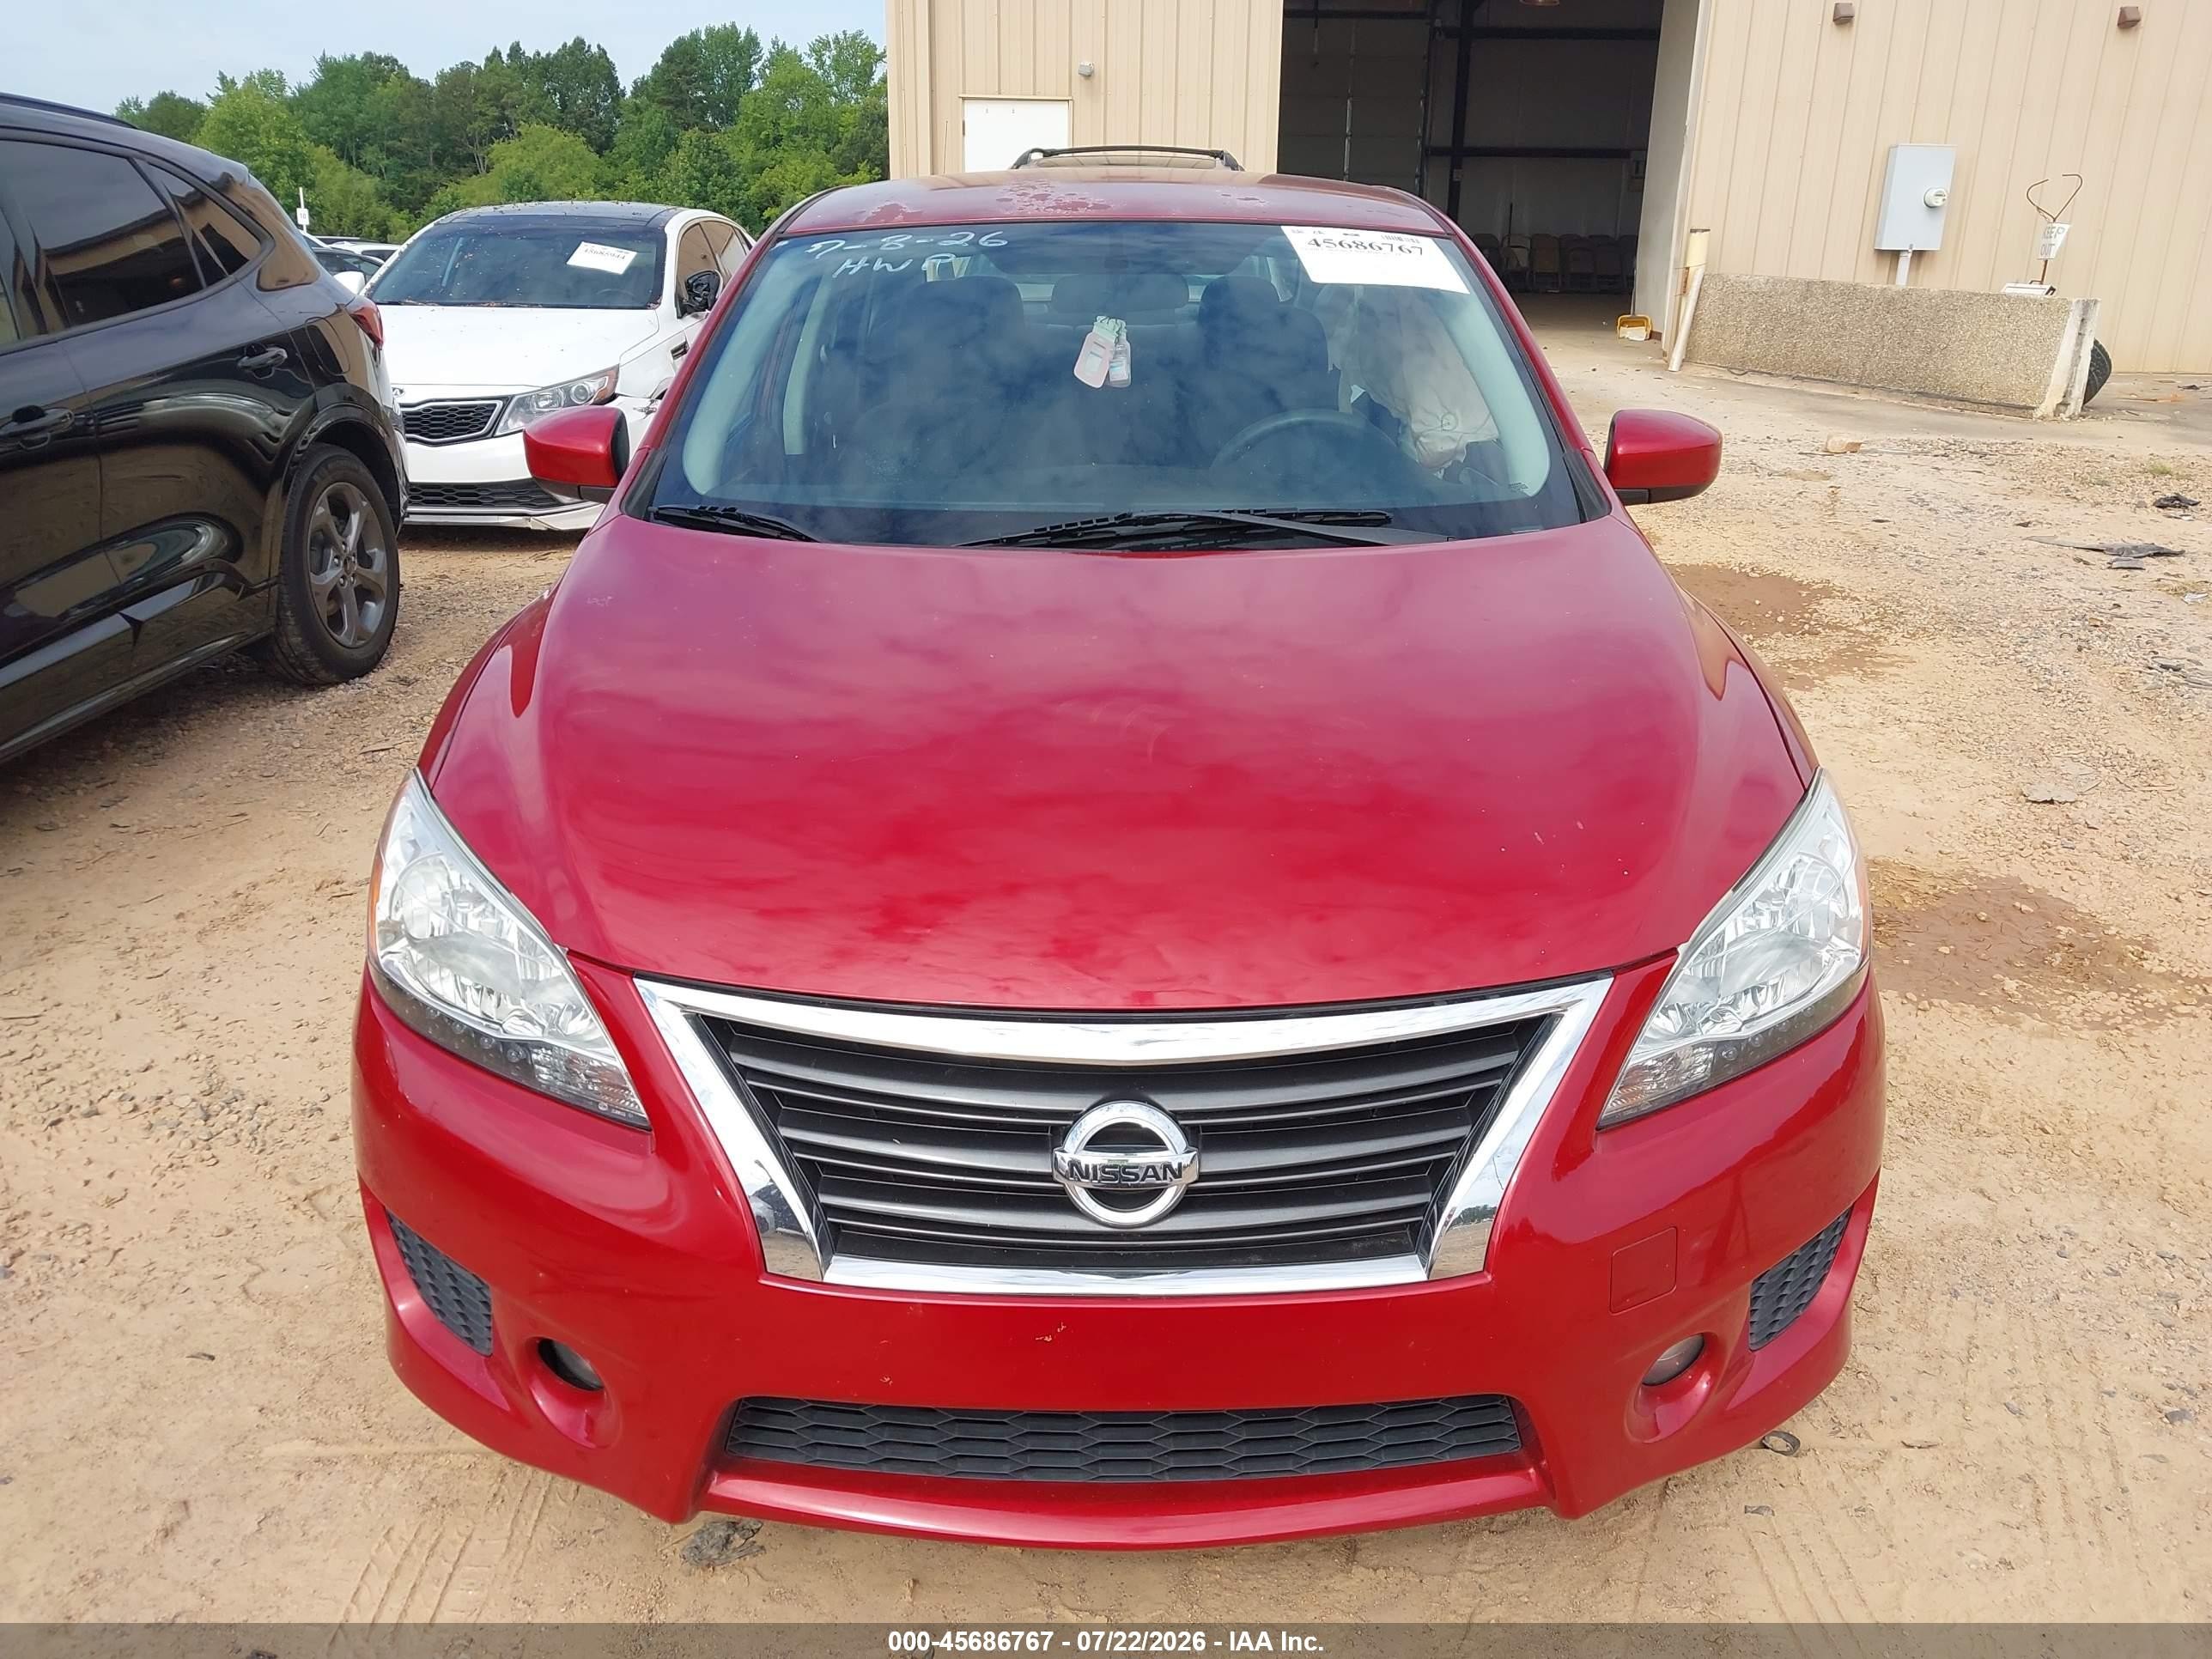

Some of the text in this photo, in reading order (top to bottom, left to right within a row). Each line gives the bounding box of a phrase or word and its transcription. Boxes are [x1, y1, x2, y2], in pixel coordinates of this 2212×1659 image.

[1307, 238, 1423, 256] 45686767
[2040, 243, 2056, 256] OUT
[1067, 1159, 1182, 1182] NISSAN
